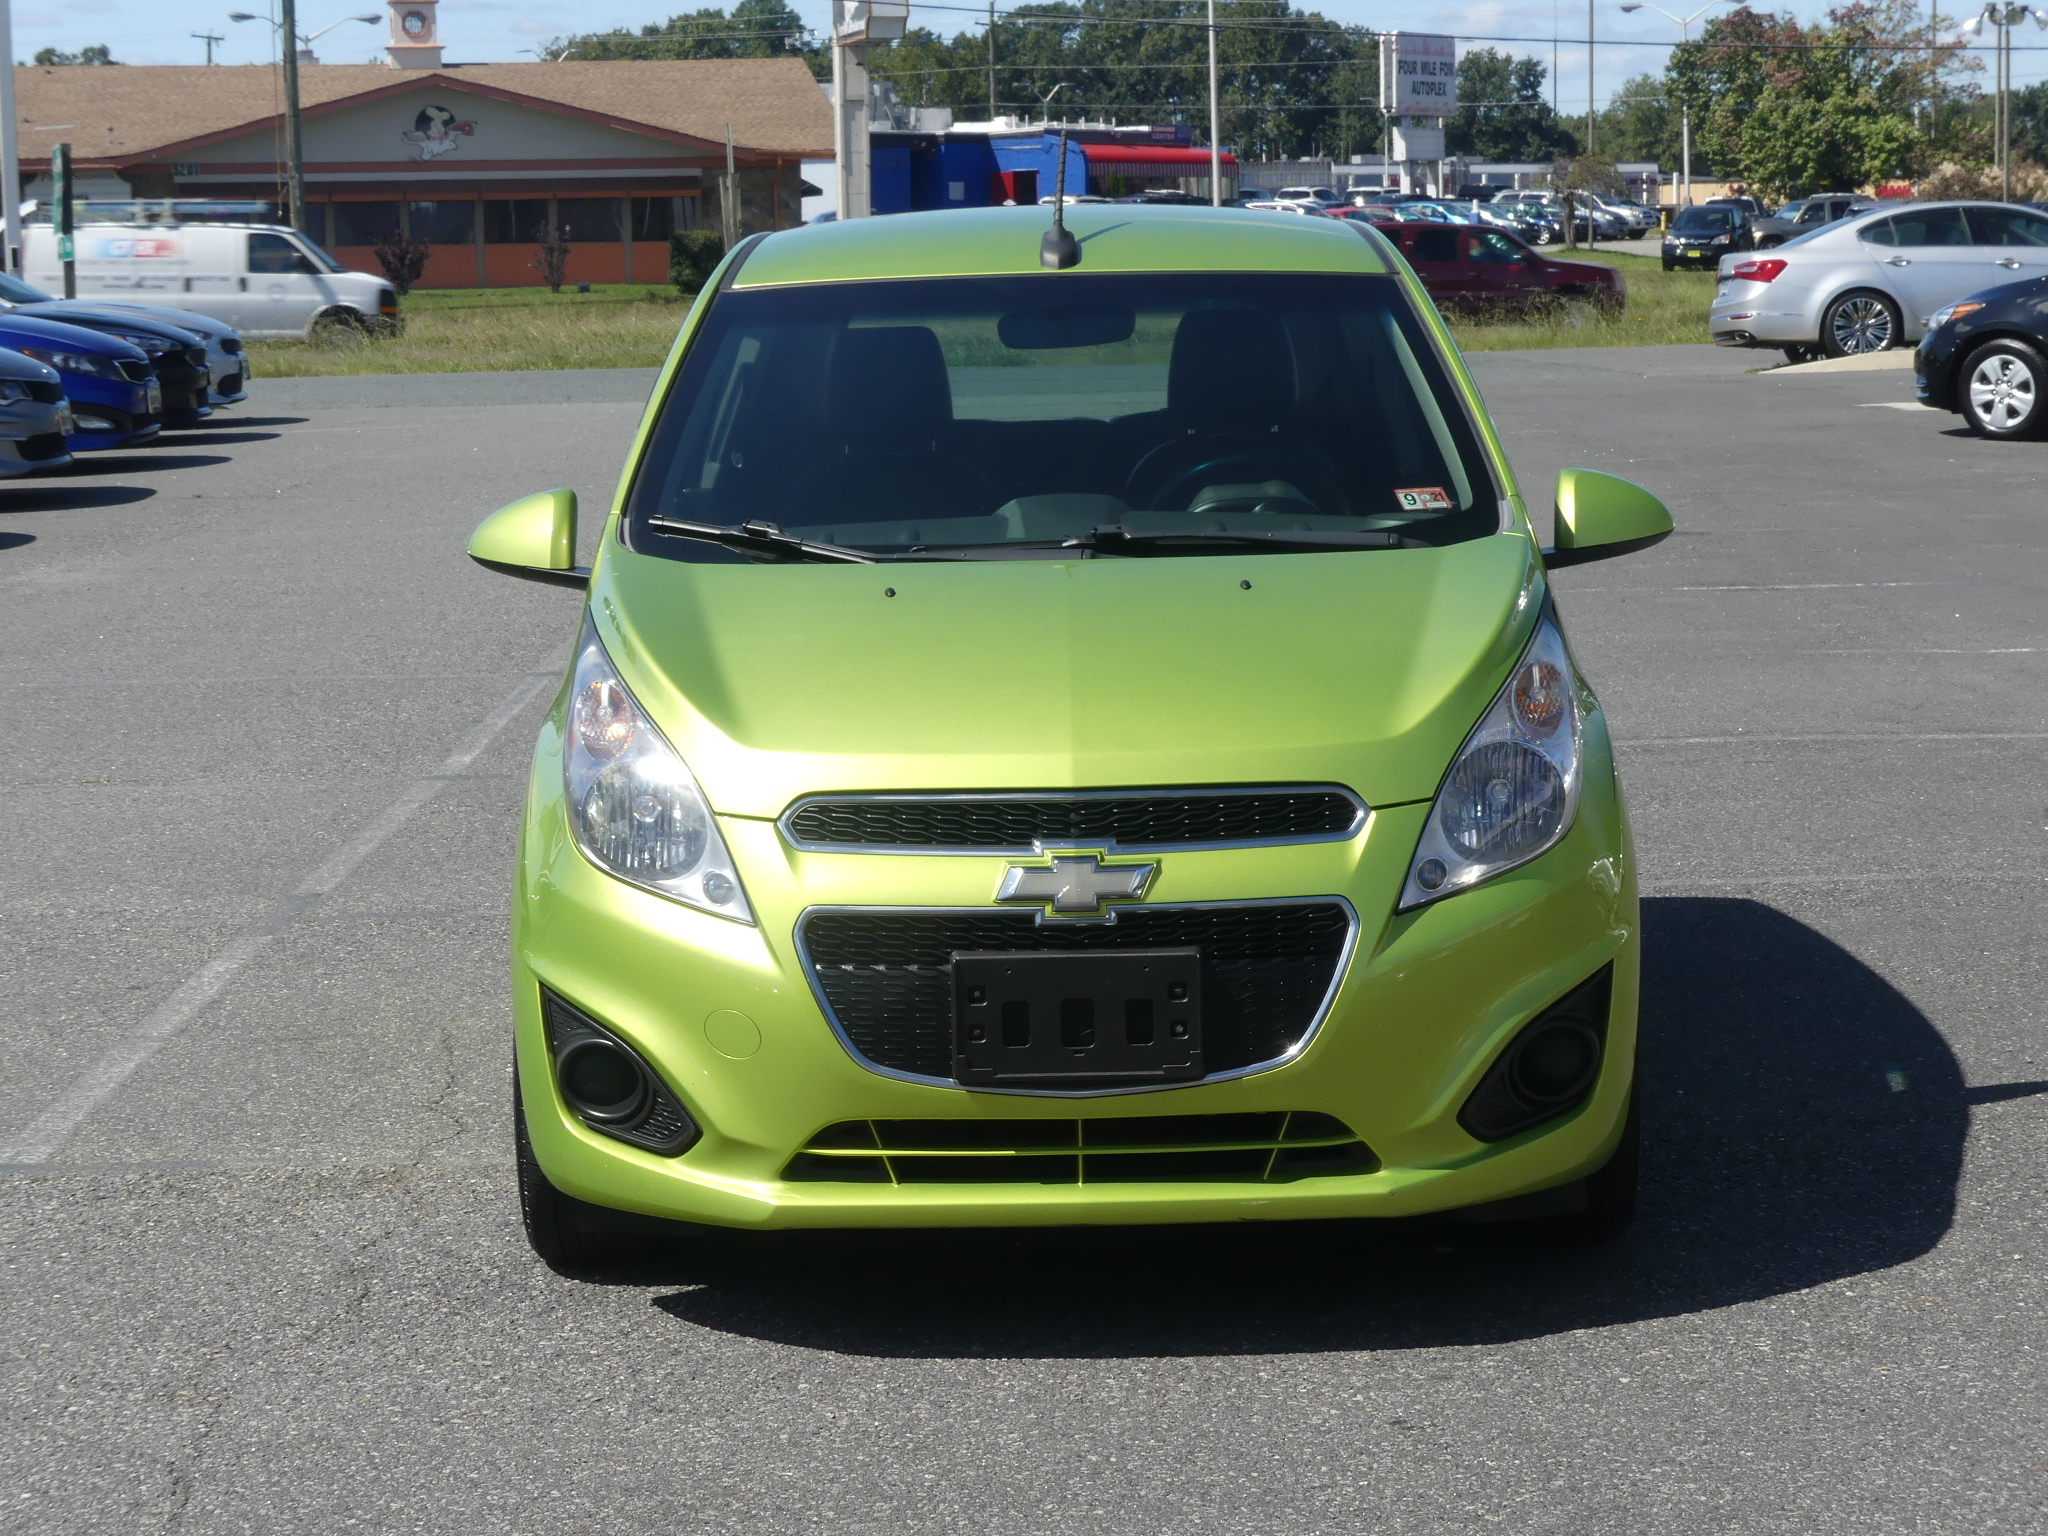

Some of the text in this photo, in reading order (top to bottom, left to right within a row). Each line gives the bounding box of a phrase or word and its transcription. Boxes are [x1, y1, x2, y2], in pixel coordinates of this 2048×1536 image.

[1398, 60, 1418, 75] FOUR
[1420, 61, 1437, 76] MILE
[1412, 81, 1447, 96] AUTOPLEX
[1404, 492, 1445, 506] 9 21
